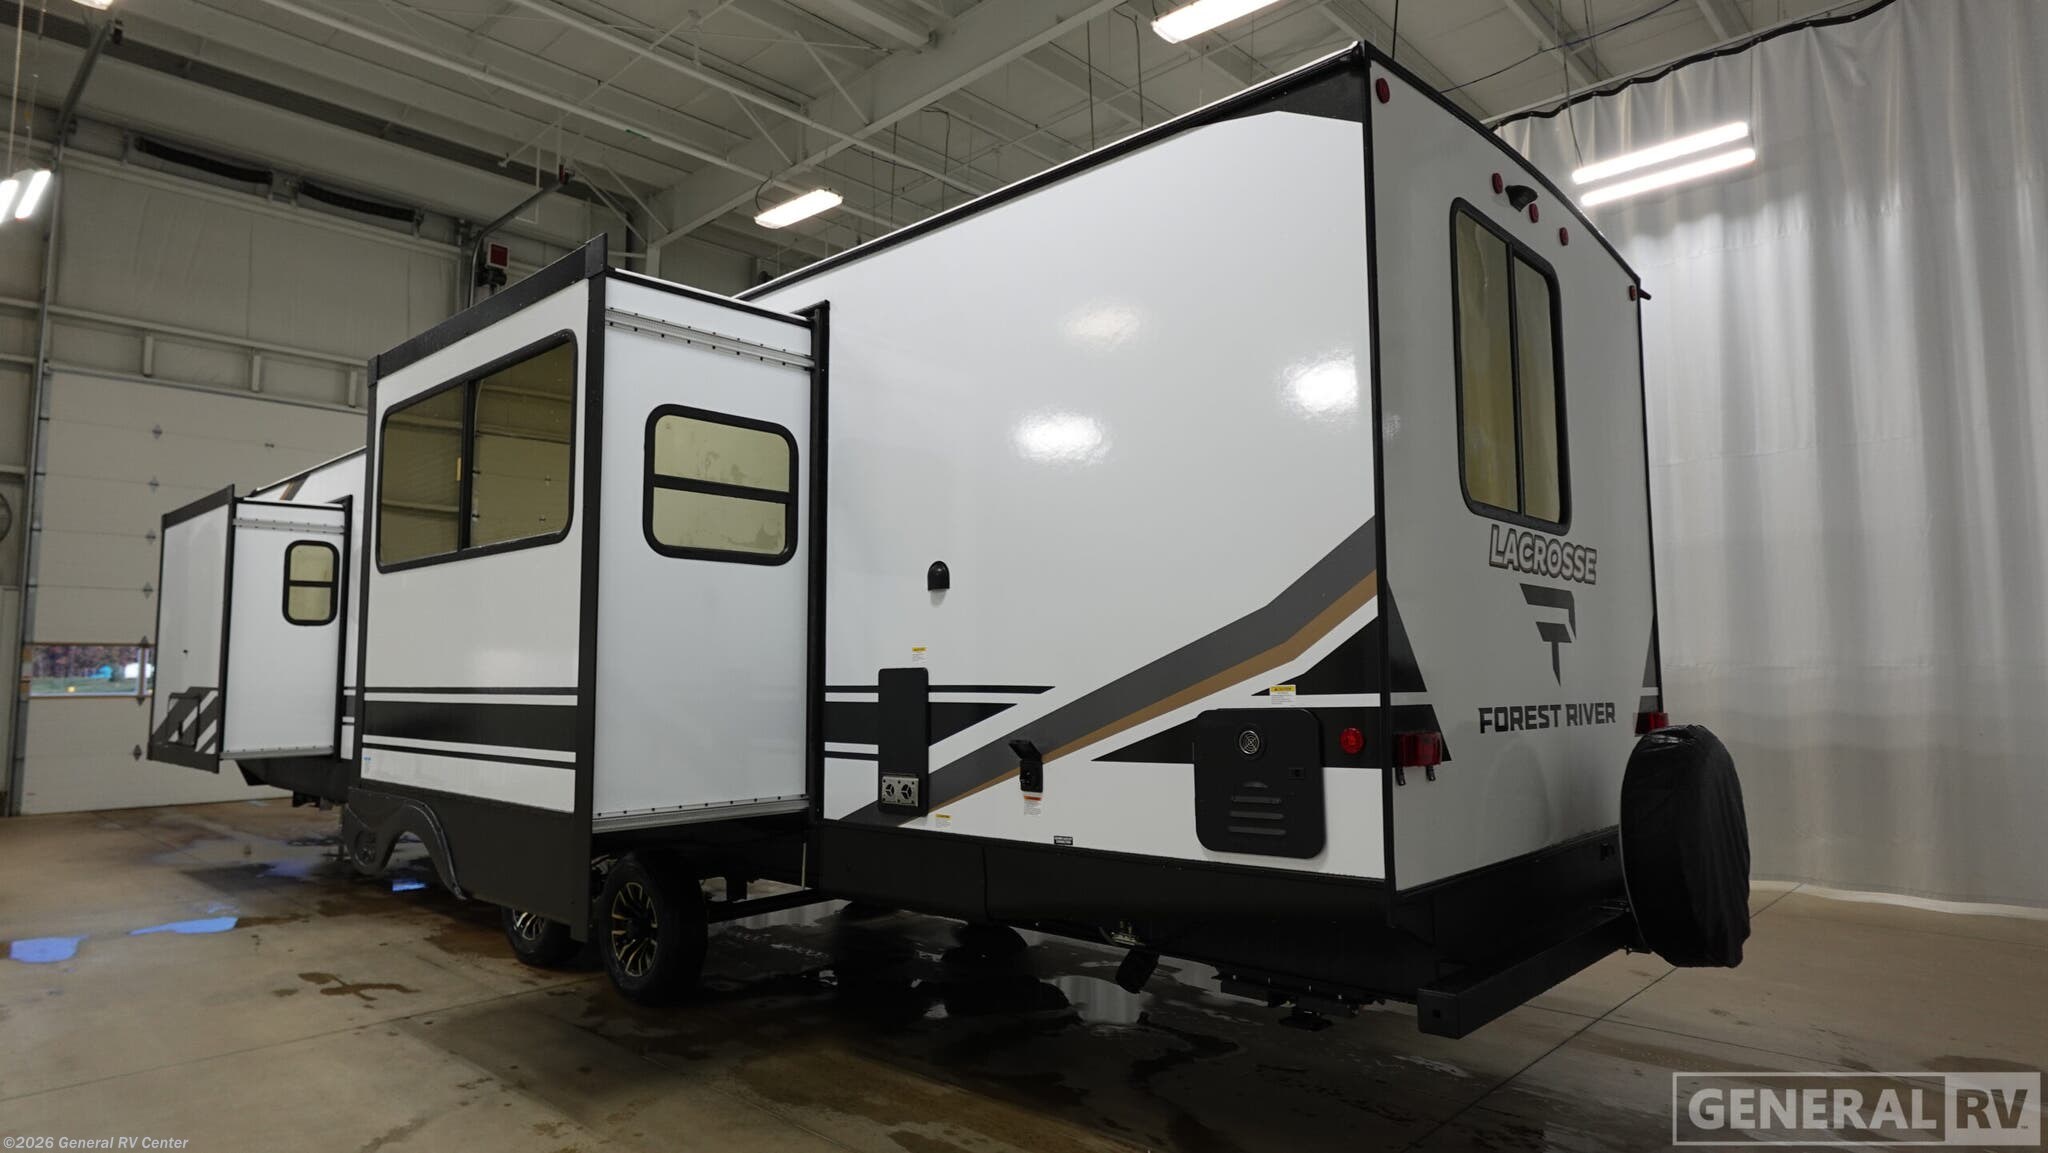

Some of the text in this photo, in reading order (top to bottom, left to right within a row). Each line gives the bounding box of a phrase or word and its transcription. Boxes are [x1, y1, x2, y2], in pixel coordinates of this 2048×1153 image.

[1489, 524, 1597, 584] LACROSSE
[1478, 702, 1616, 733] FOREST RIVER
